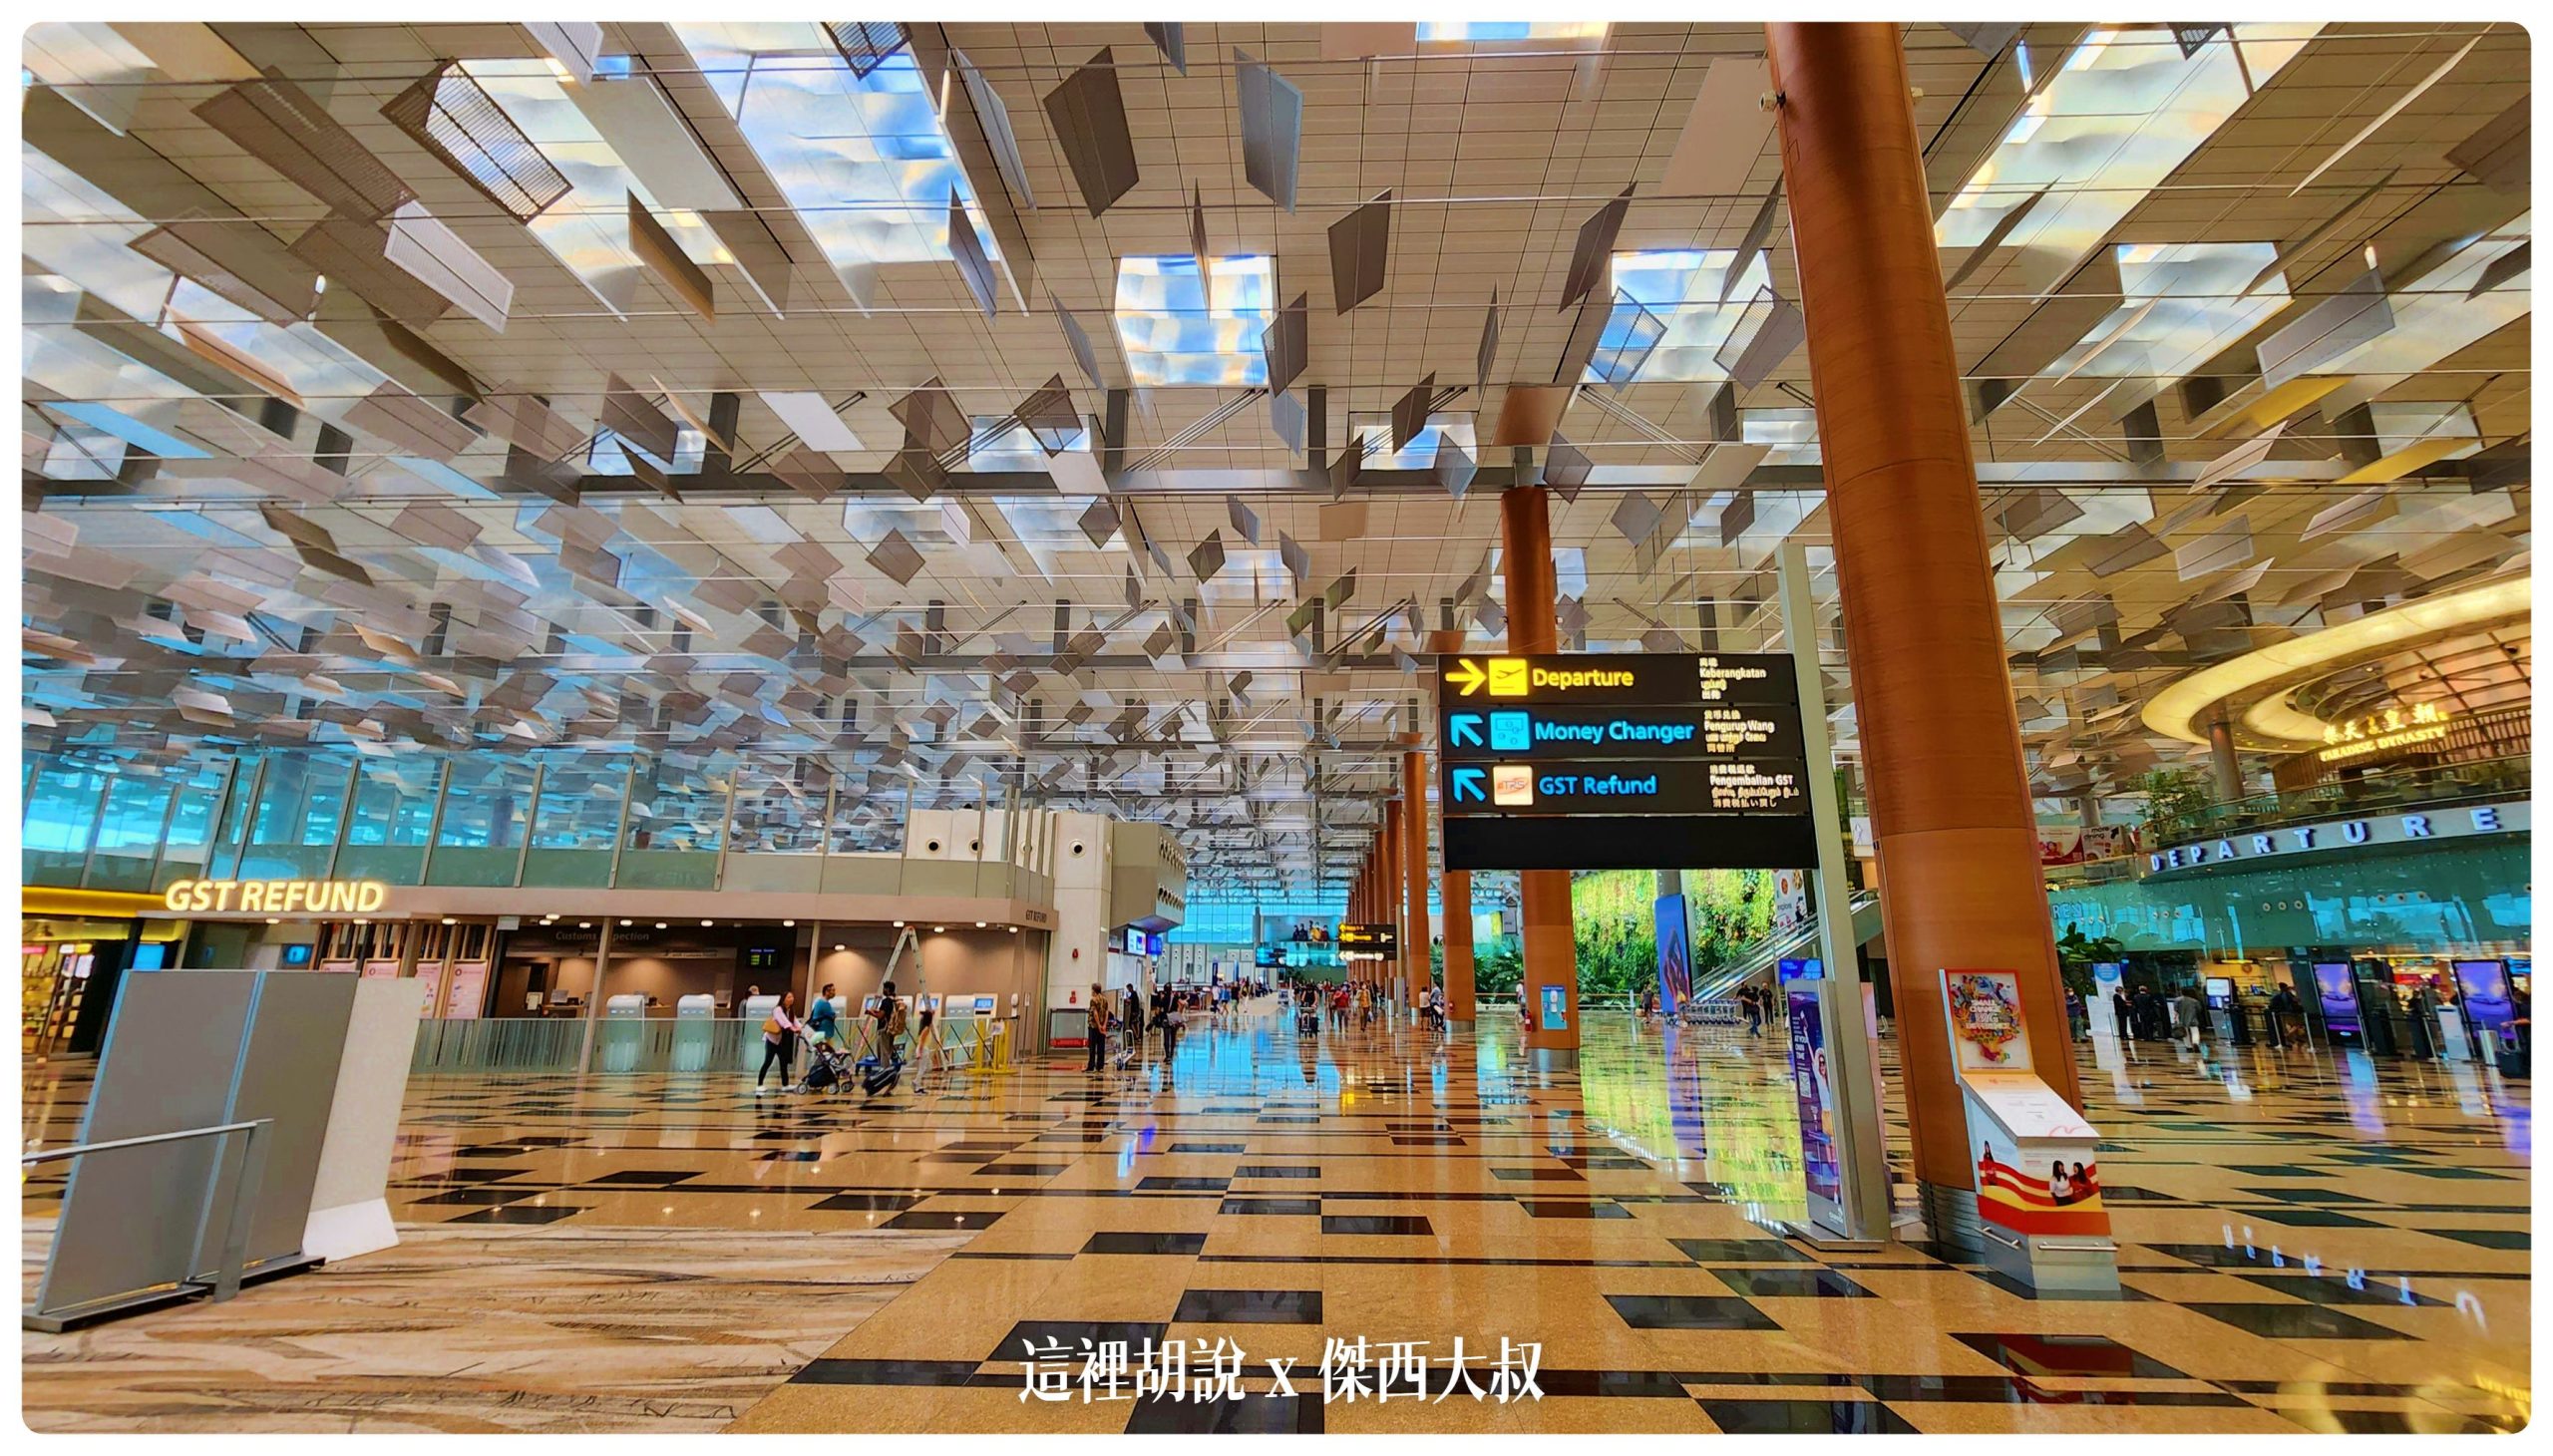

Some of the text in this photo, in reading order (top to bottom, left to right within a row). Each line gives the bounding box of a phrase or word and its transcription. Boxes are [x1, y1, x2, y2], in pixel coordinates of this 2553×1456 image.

[1532, 667, 1635, 690] Departure
[1699, 667, 1767, 680] Keberangkatan
[1535, 721, 1604, 745] Money
[1608, 720, 1695, 745] Changer
[1704, 720, 1775, 734] Pengurup Wang
[2319, 726, 2445, 762] PARADISE DYNASTY
[1539, 776, 1578, 796] GST
[1584, 775, 1657, 796] Refund
[1709, 775, 1793, 788] Pengembalian GST
[2150, 808, 2498, 872] DEPARTURE
[165, 880, 384, 911] GST REFUND
[555, 931, 596, 941] Customs
